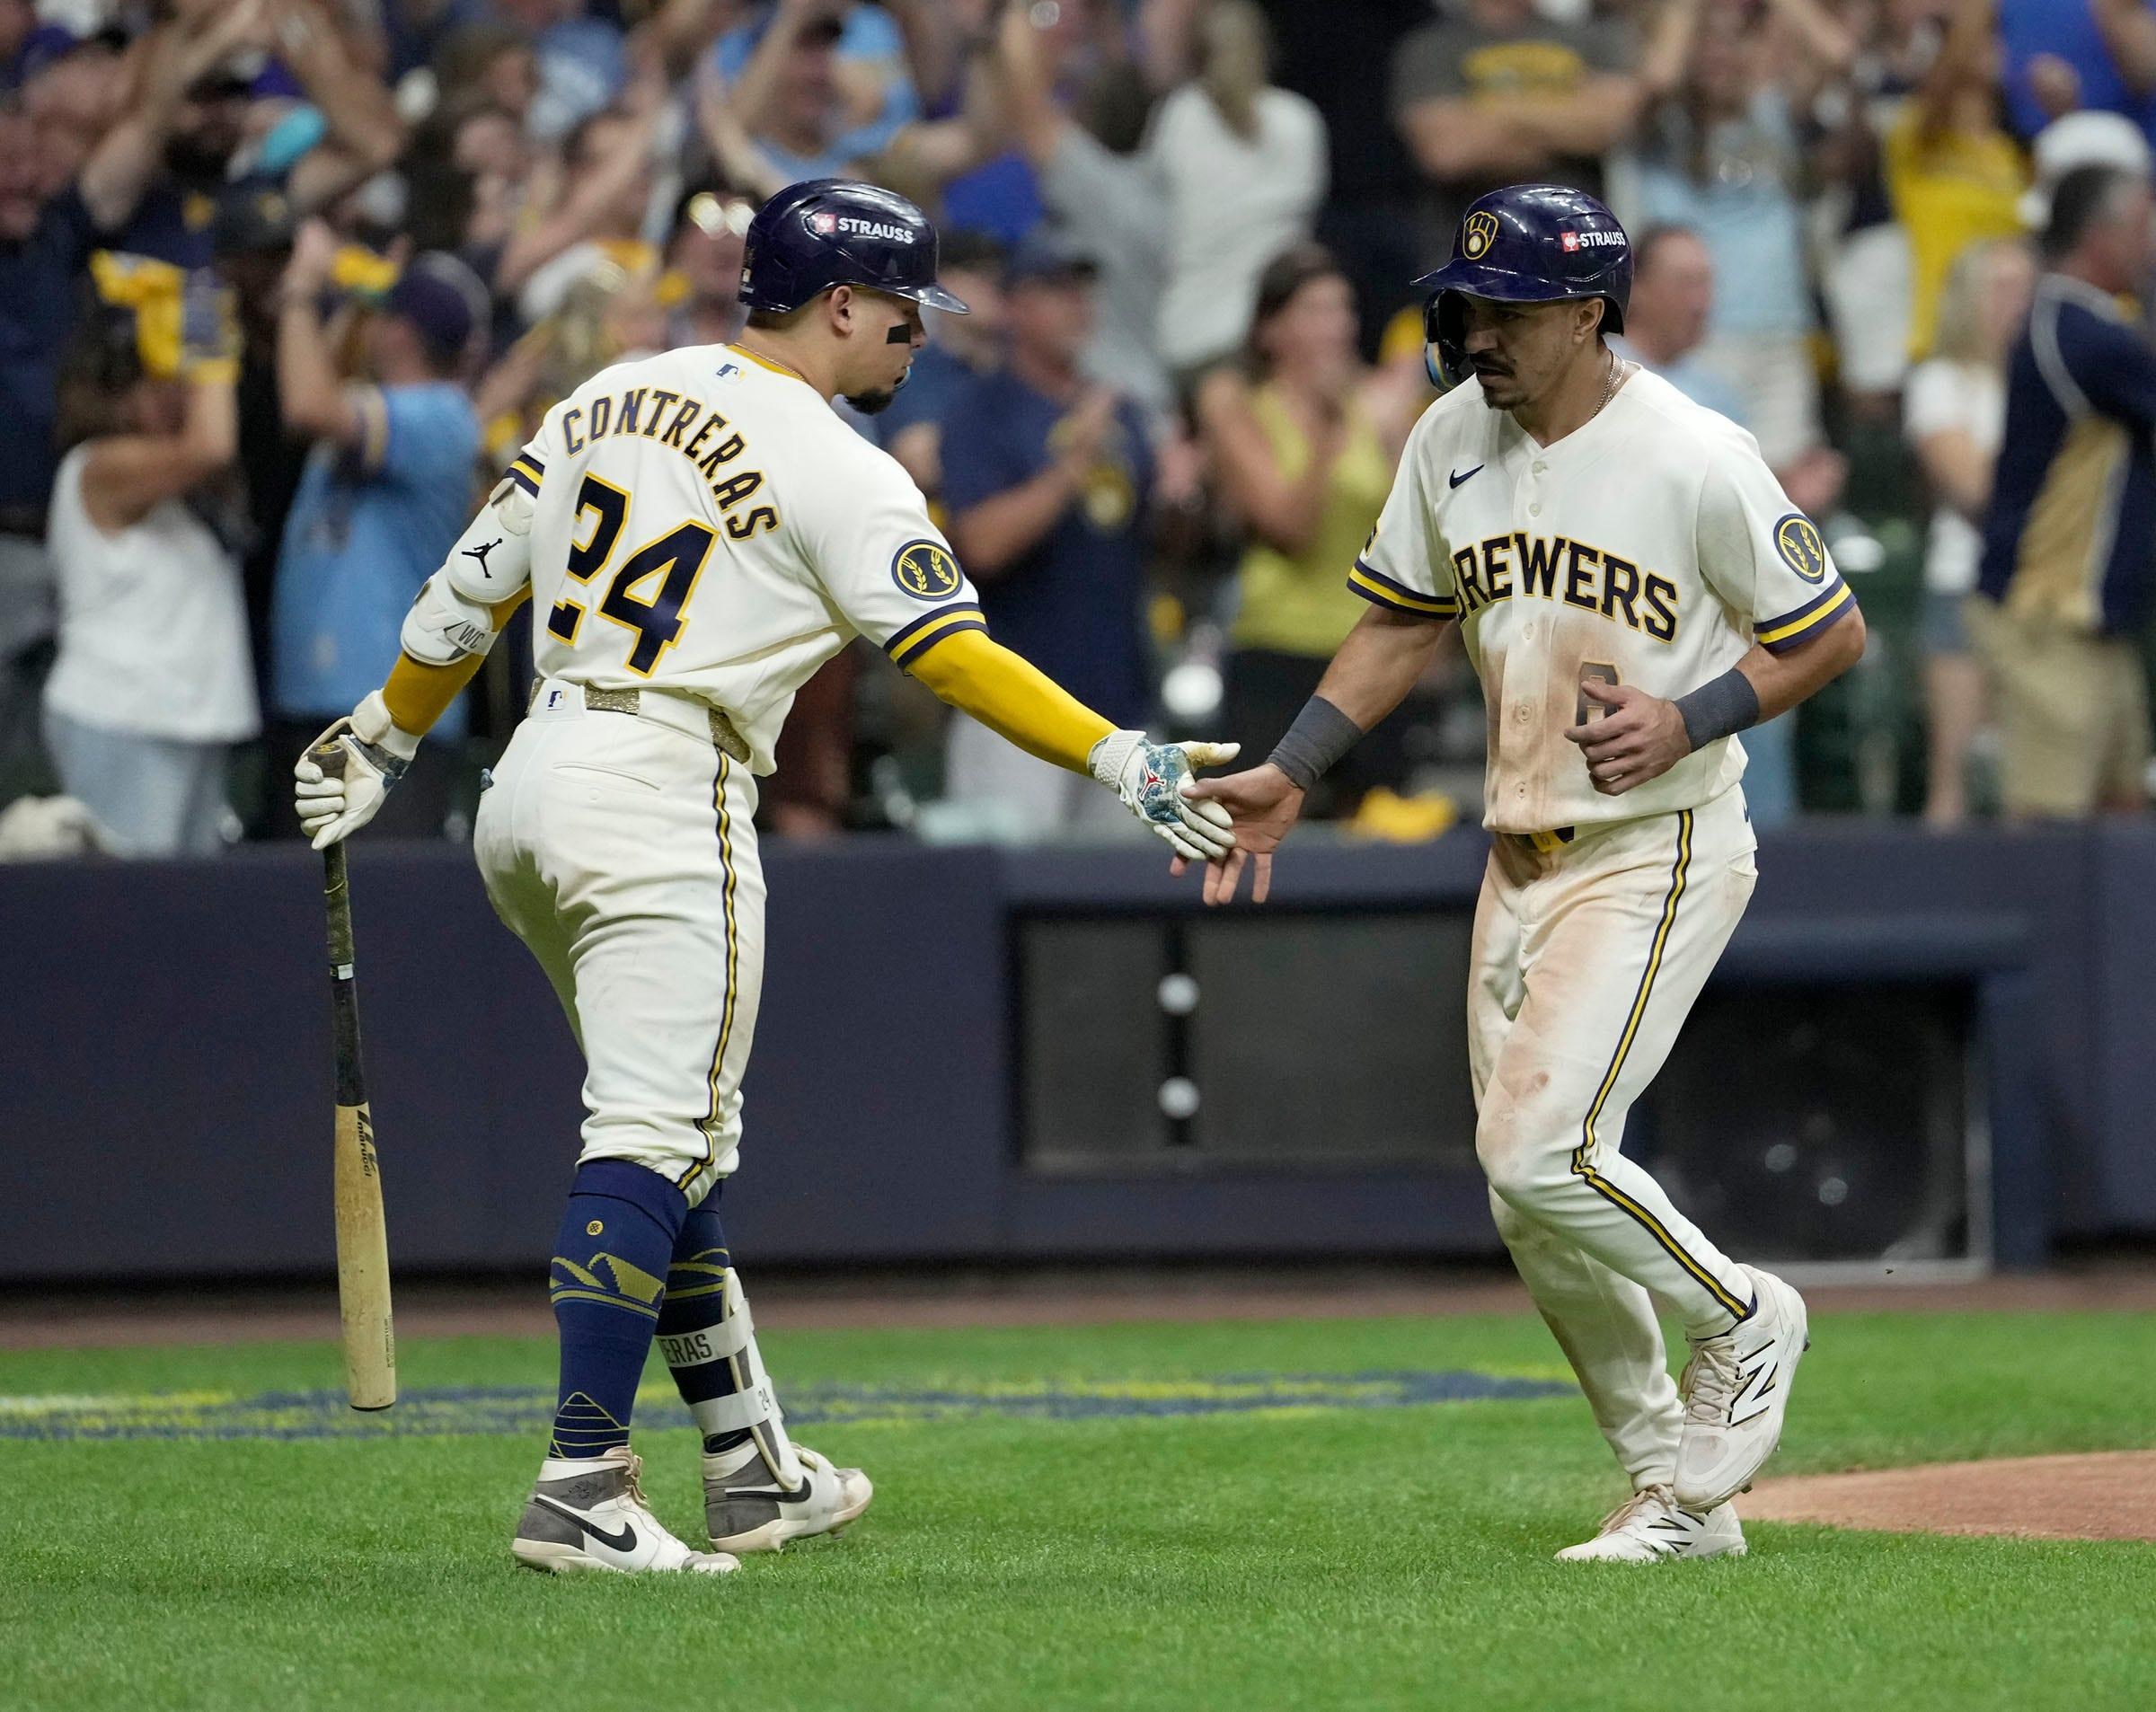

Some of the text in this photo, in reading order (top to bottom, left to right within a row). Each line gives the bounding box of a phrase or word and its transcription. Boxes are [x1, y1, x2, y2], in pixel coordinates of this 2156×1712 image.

[837, 217, 914, 244] STRAUSS
[1580, 231, 1626, 249] STRAUSS
[561, 386, 782, 541] CONTRERAS
[545, 470, 720, 679] 24
[1450, 531, 1679, 645] REWERS
[458, 624, 485, 649] WC
